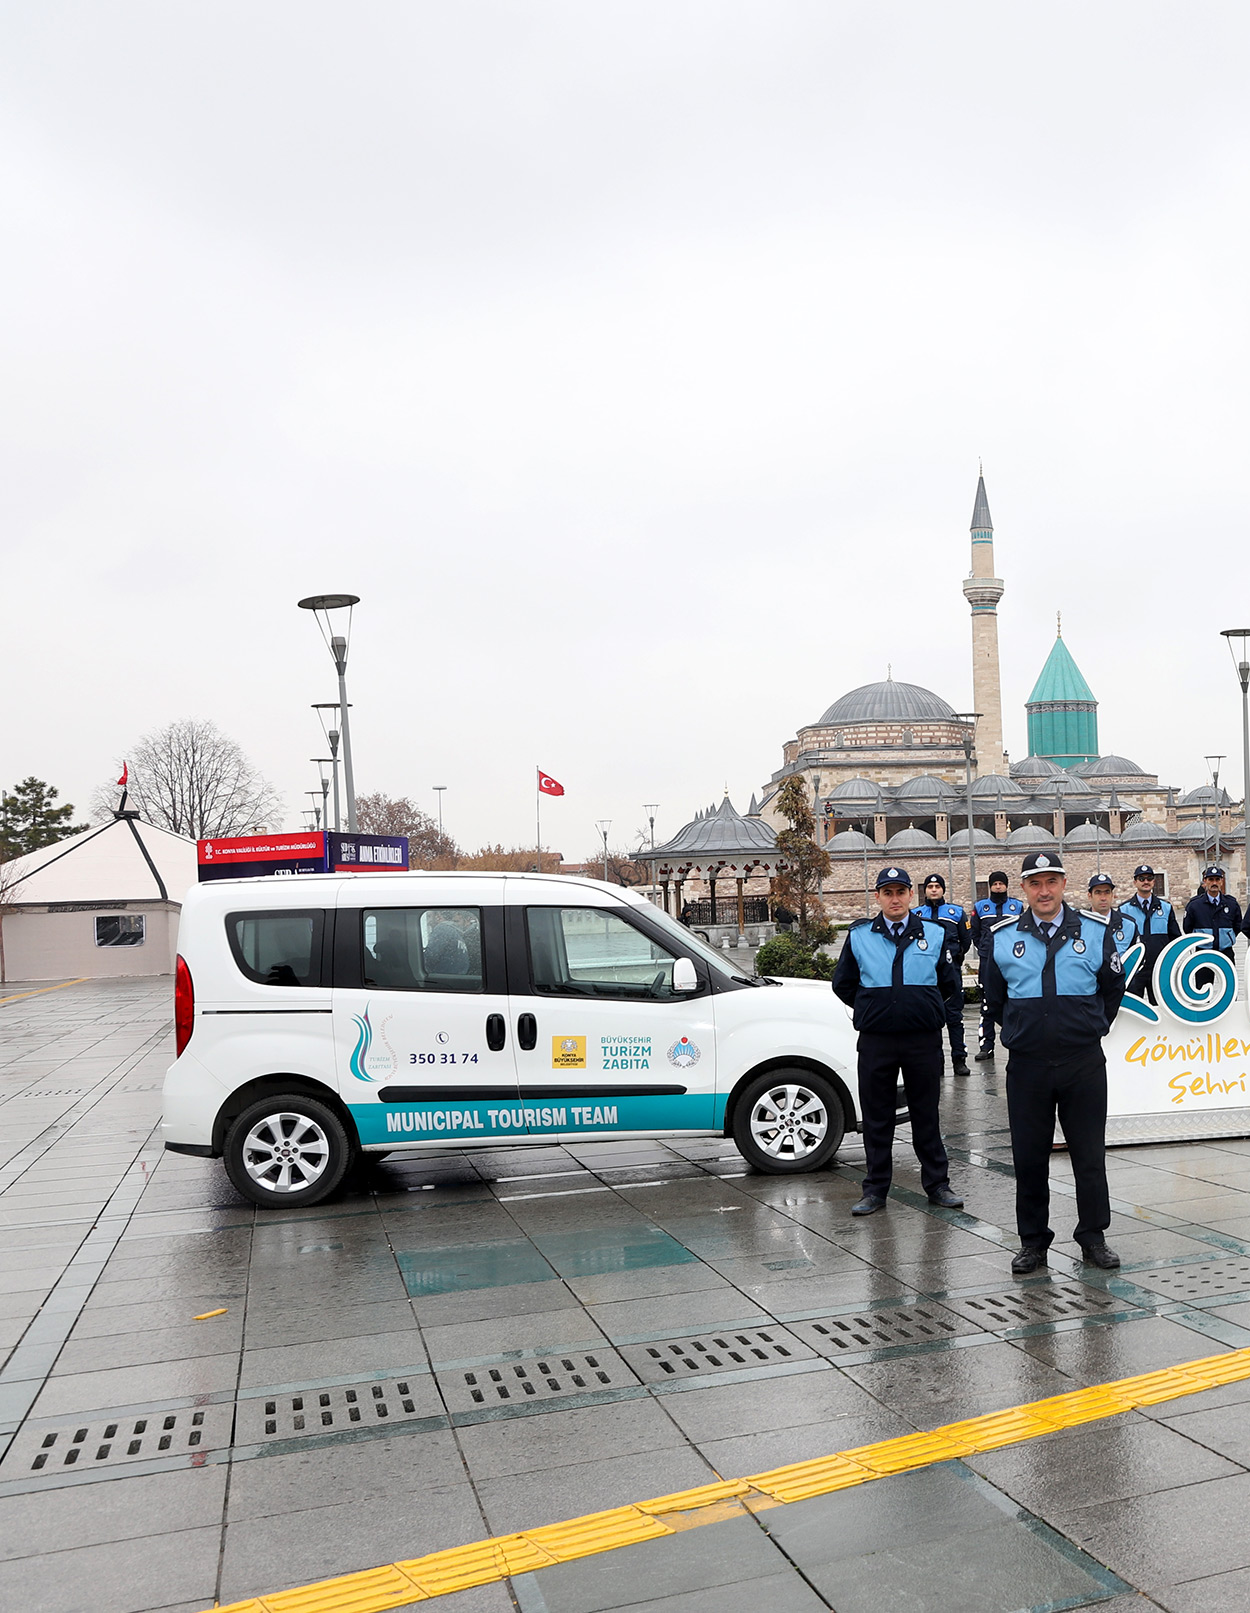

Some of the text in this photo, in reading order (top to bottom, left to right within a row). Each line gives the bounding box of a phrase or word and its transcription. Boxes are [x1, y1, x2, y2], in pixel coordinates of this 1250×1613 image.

[600, 1036, 652, 1044] BÜYÜKŞEHİR
[601, 1046, 651, 1057] TURİZM
[409, 1053, 479, 1064] 350 31 74
[602, 1058, 650, 1070] ZABITA
[1168, 1072, 1247, 1104] Şehri
[386, 1106, 618, 1132] MUNICIPAL TOURISM TEAM
